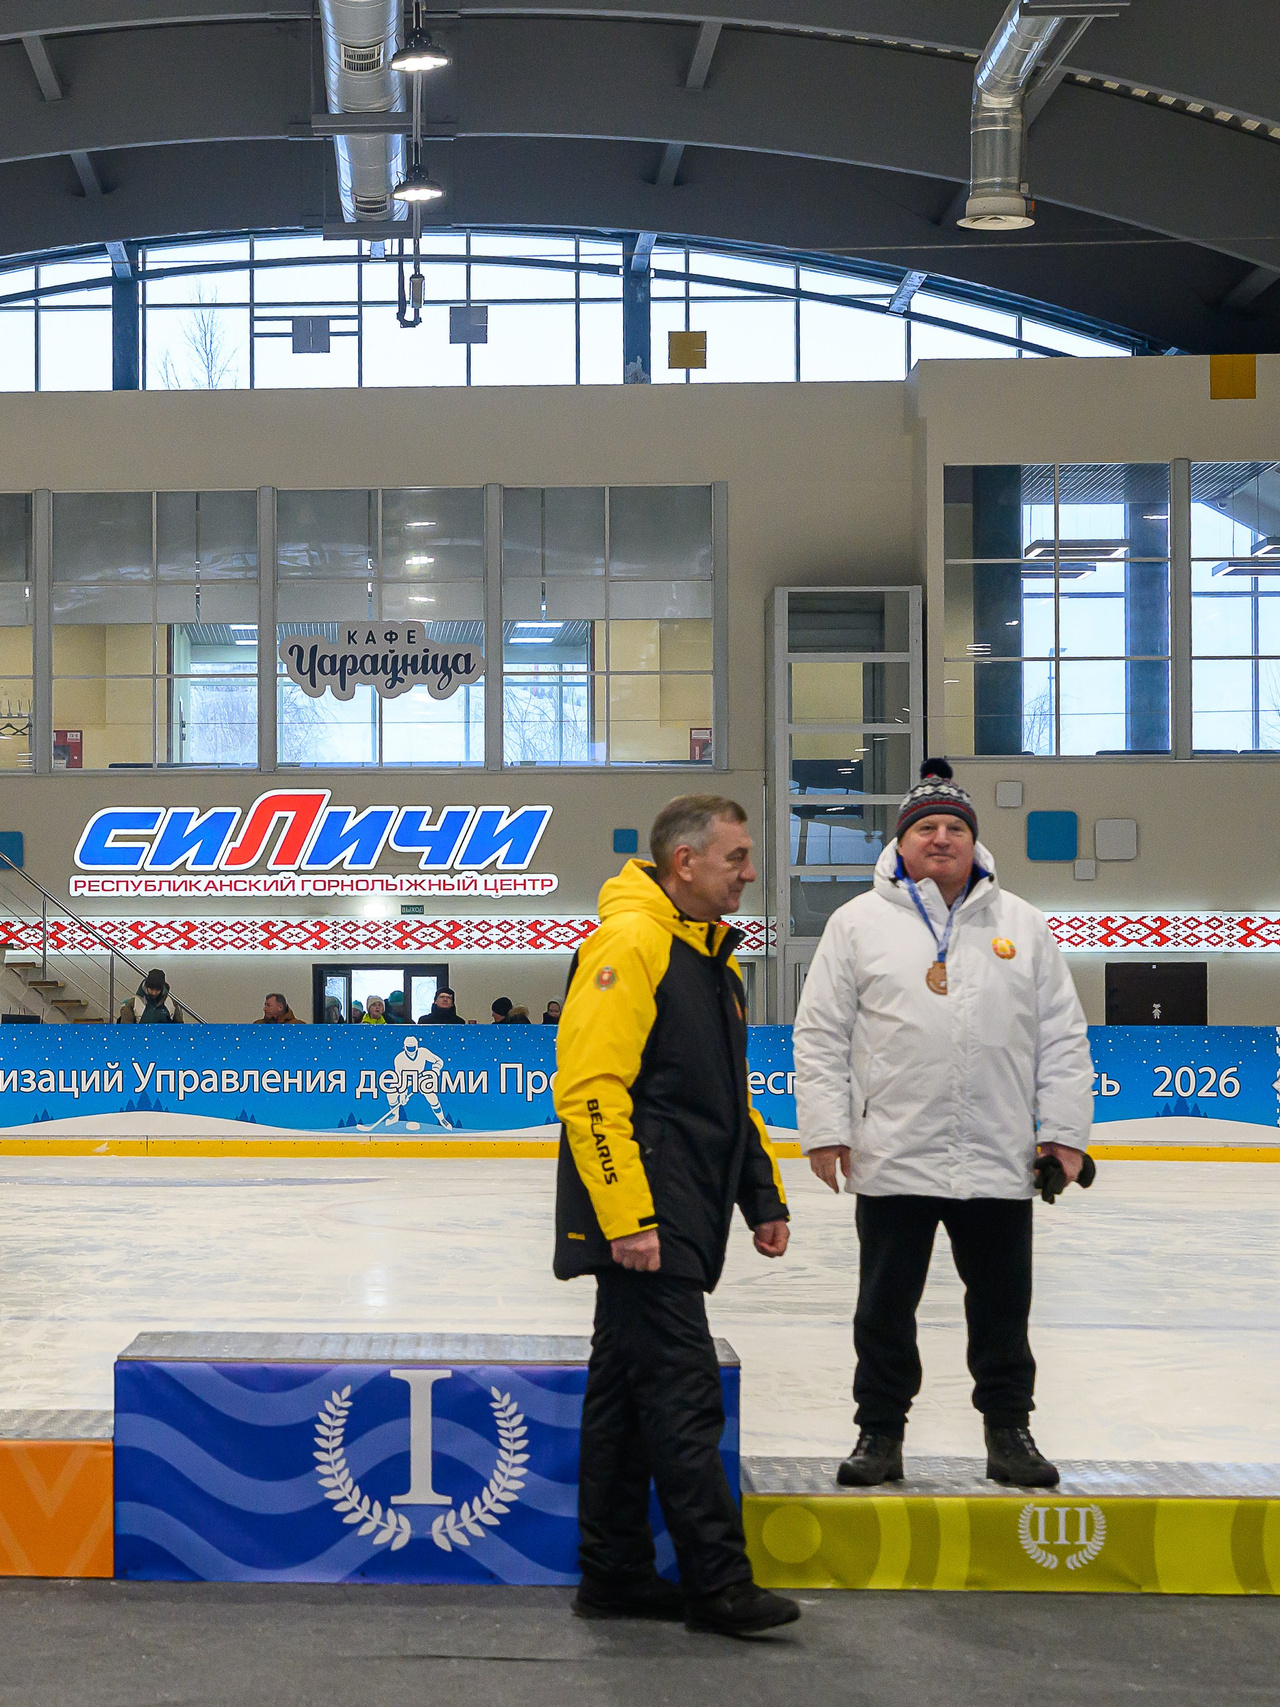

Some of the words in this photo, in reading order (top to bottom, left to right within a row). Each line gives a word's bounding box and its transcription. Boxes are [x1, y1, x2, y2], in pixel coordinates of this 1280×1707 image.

[347, 630, 417, 645] КАФЕ
[288, 644, 477, 692] Чараўніца
[73, 876, 296, 892] РЕСПУБЛИКАНСКИЙ
[301, 875, 478, 892] ГОРНОЛЫЖНЫЙ
[484, 878, 554, 893] ЦЕНТР
[131, 1061, 346, 1101] Управления
[354, 1069, 489, 1100] делами
[1151, 1065, 1241, 1098] 2026
[586, 1098, 618, 1186] BELARUS
[389, 1368, 453, 1505] I
[1034, 1506, 1093, 1546] III
